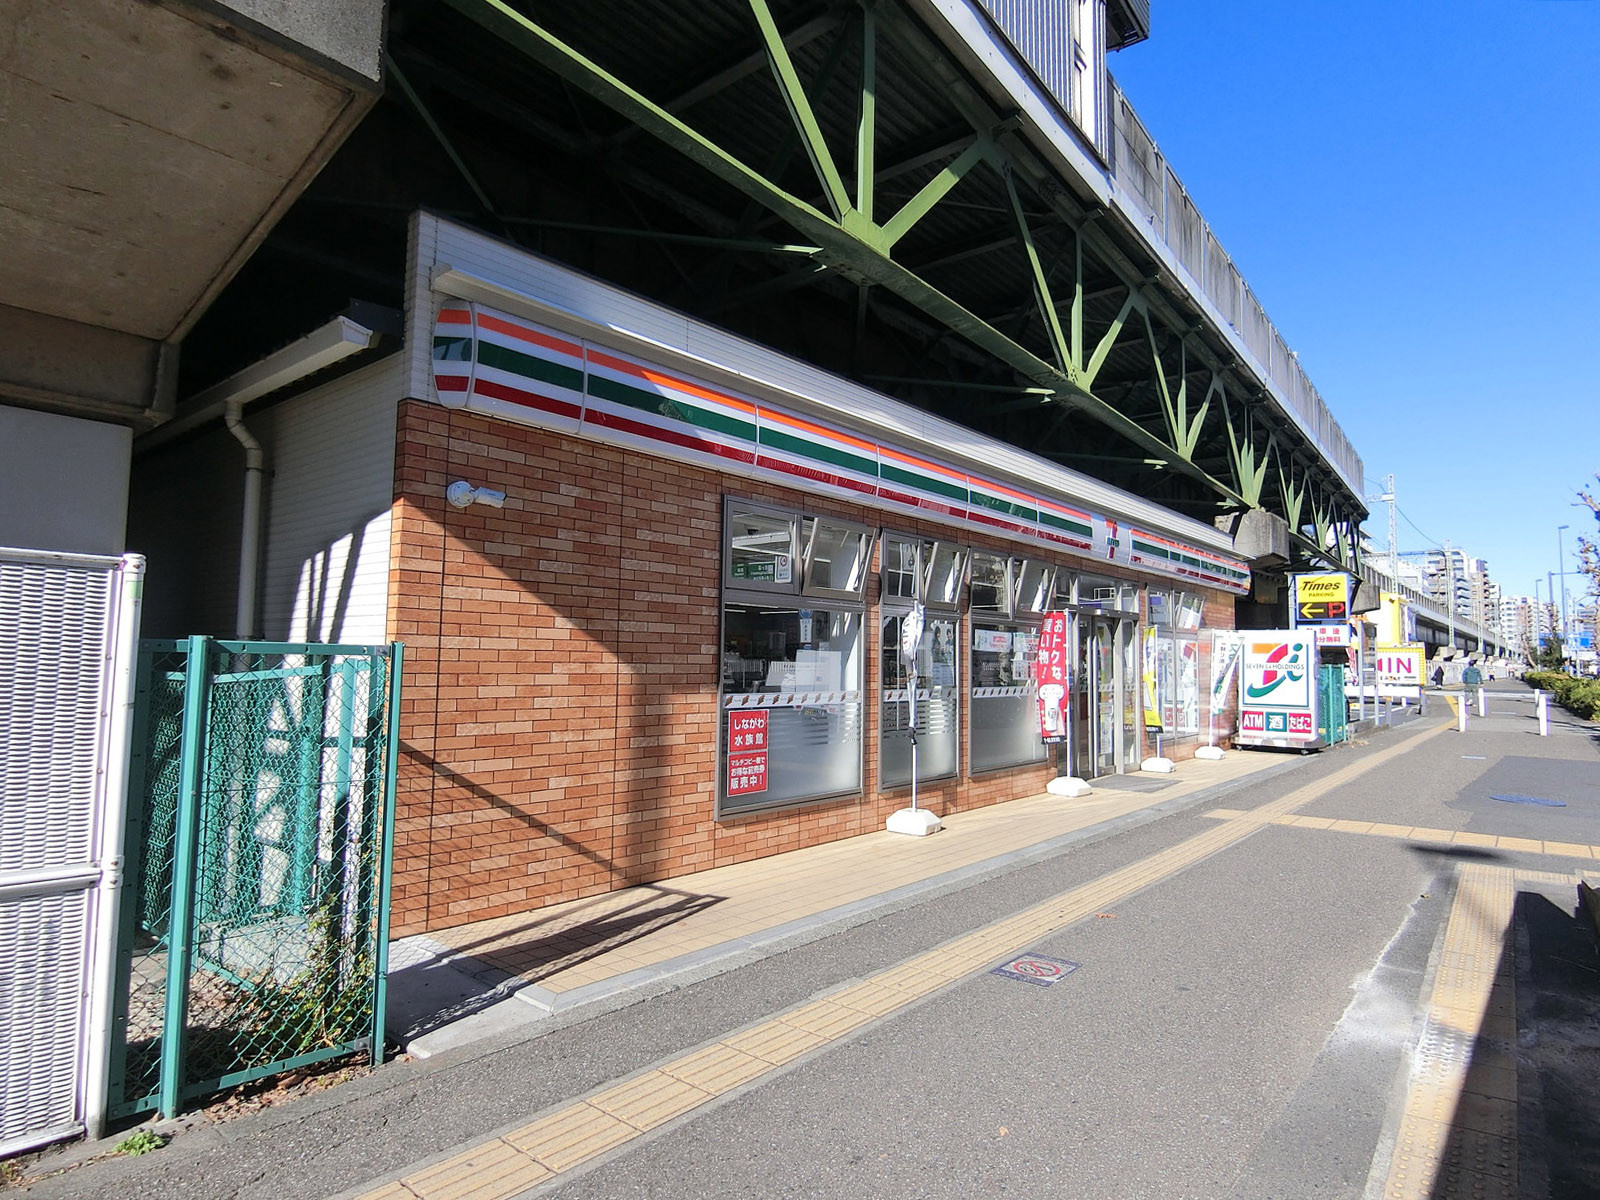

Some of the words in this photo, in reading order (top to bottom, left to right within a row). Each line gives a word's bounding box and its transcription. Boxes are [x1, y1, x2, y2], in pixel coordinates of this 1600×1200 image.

[1302, 581, 1341, 591] Times
[1328, 602, 1345, 618] P
[1050, 619, 1063, 680] おトクな
[734, 718, 765, 730] しながわ
[1243, 714, 1263, 728] ATM
[1268, 714, 1284, 729] 酒
[1288, 716, 1311, 731] たばこ
[734, 732, 764, 746] 水族館
